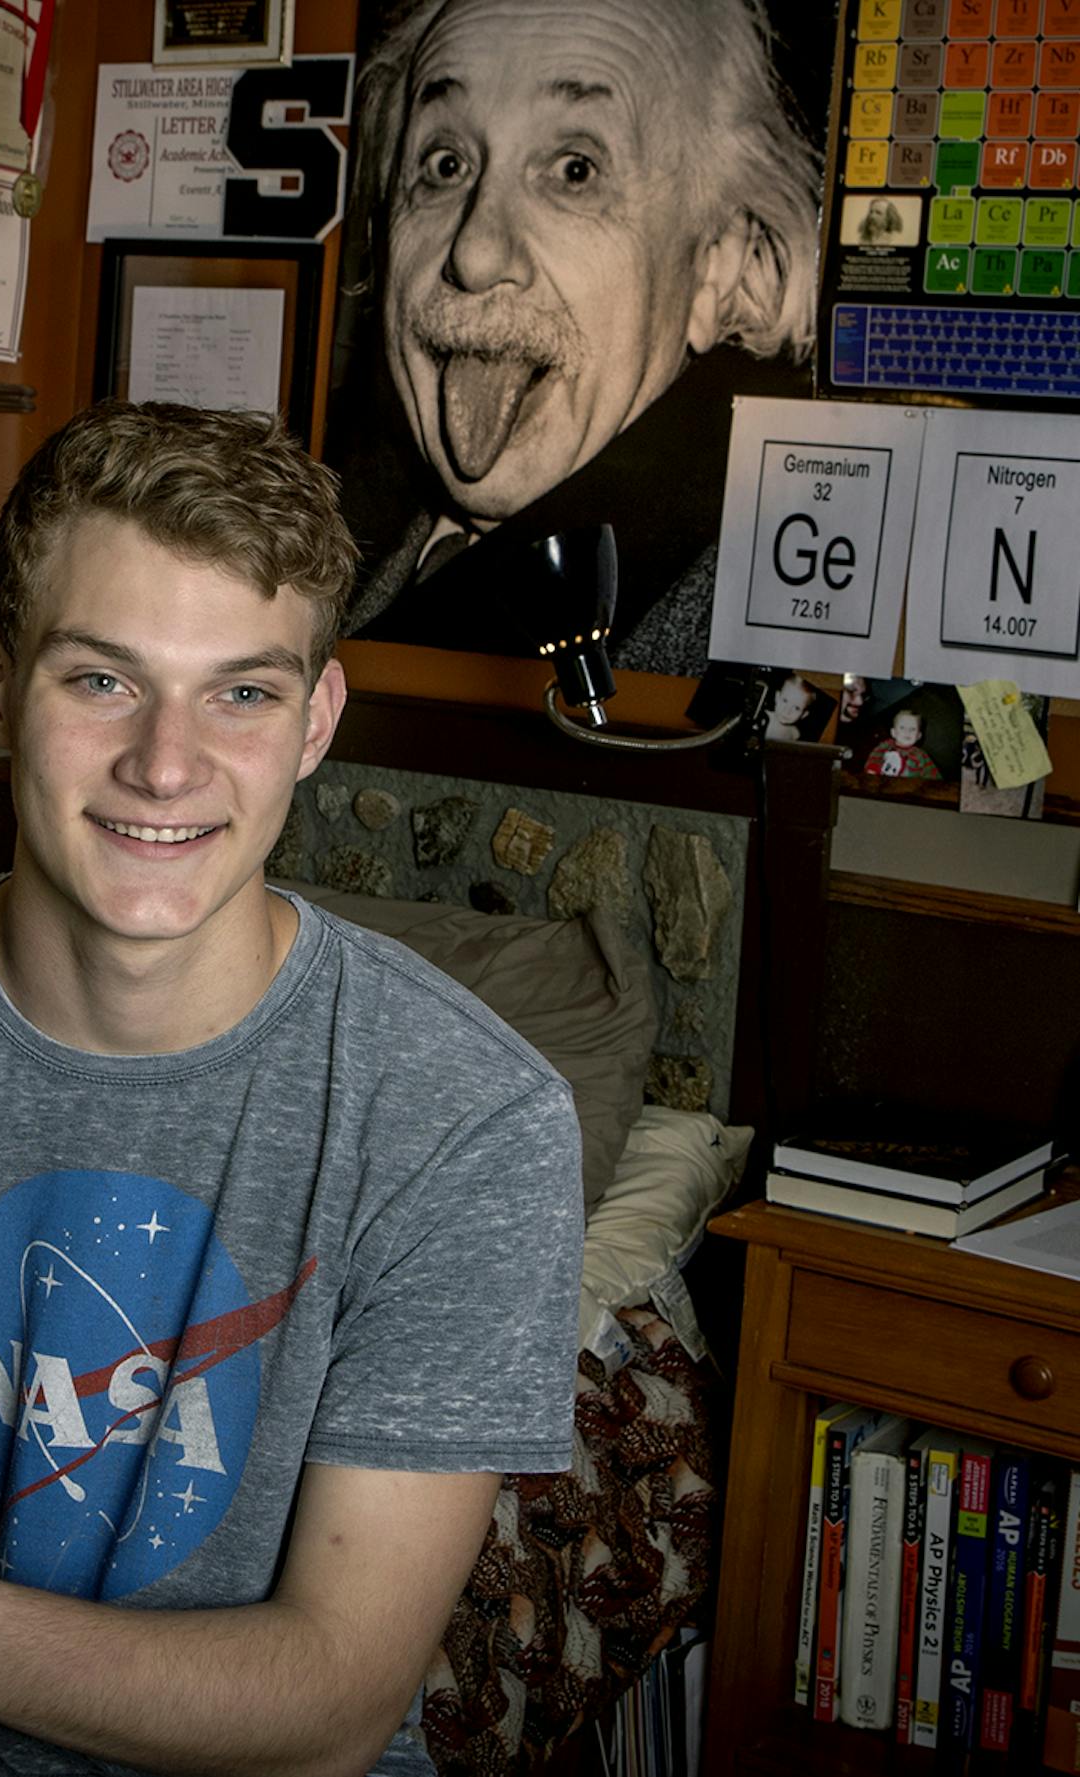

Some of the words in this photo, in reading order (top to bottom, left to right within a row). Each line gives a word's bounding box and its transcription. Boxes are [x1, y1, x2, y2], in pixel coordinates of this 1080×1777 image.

[873, 1, 887, 17] K
[914, 0, 936, 16] Ca
[961, 0, 980, 15] Sc
[1011, 0, 1027, 14] Ti
[864, 50, 887, 66] Rb
[911, 50, 931, 66] Sr
[960, 49, 975, 64] Y
[1004, 48, 1025, 63] Zr
[1050, 48, 1076, 63] Nb
[111, 78, 175, 98] STILLWATER
[175, 77, 204, 97] AREA
[205, 77, 233, 97] HIGH
[127, 100, 189, 110] Stillwater,
[860, 98, 882, 114] Cs
[905, 98, 927, 114] Ba
[999, 98, 1023, 114] Hf
[1049, 98, 1069, 114] Ta
[160, 116, 217, 135] LETTER
[160, 147, 207, 162] Academic
[208, 148, 230, 162] Ach
[858, 147, 876, 163] Fr
[901, 148, 923, 164] Ra
[994, 148, 1019, 165] Rf
[1039, 148, 1068, 165] Db
[942, 204, 963, 220] La
[987, 204, 1012, 221] Ce
[1038, 207, 1058, 223] Pr
[935, 253, 961, 270] Ac
[985, 255, 1006, 271] Th
[1031, 256, 1053, 272] Pa
[784, 454, 870, 478] Germanium
[987, 466, 1057, 491] Nitrogen
[813, 482, 832, 502] 32
[1014, 496, 1024, 515] 7
[773, 513, 856, 590] Ge
[990, 527, 1037, 605] N
[791, 599, 831, 620] 72.61
[983, 615, 1038, 637] 14.007
[831, 1462, 842, 1488] STEPS
[908, 1480, 918, 1507] STEPS
[1008, 1465, 1019, 1505] KAPLAN
[830, 1489, 841, 1502] TO
[811, 1503, 820, 1525] Math
[830, 1502, 840, 1510] A
[908, 1507, 917, 1522] TO
[907, 1521, 916, 1529] A
[998, 1509, 1022, 1545] AP
[808, 1535, 818, 1567] Science
[866, 1495, 888, 1601] FUNDAMENTALS
[928, 1532, 945, 1559] AP
[1005, 1550, 1018, 1588] HUMAN
[805, 1570, 815, 1606] Workout
[954, 1571, 968, 1616] HISTORY
[922, 1565, 942, 1631] Physics
[864, 1602, 877, 1621] OF
[1000, 1589, 1015, 1651] GEOGRAPHY
[800, 1629, 810, 1647] ACT
[924, 1635, 938, 1648] 2
[953, 1617, 965, 1653] WORLD
[861, 1622, 881, 1677] PHYSICS
[964, 1633, 975, 1656] 2016
[950, 1659, 973, 1694] AP
[819, 1682, 831, 1709] 2018
[896, 1703, 909, 1730] 2018
[952, 1697, 962, 1737] KAPLAN
